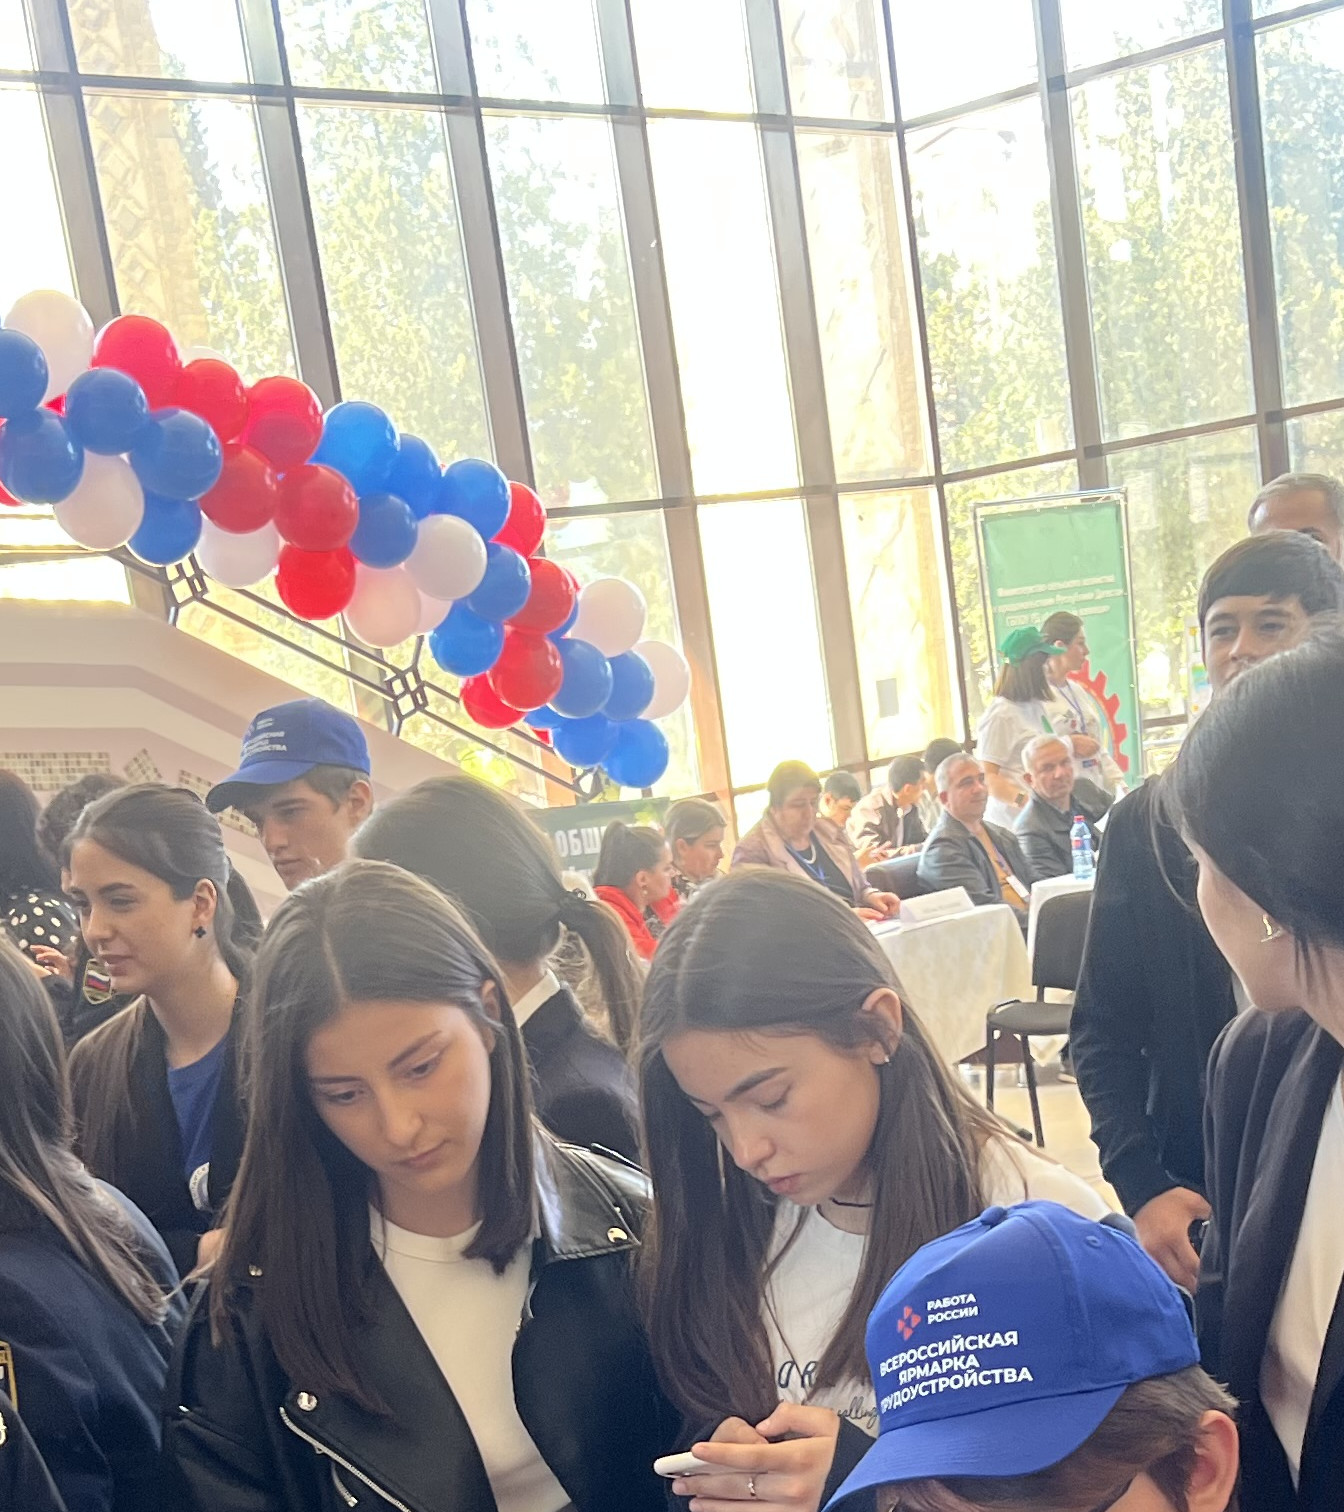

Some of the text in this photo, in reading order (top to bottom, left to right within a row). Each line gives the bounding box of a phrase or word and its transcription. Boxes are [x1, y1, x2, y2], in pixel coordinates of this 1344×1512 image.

[926, 1293, 977, 1311] РАБОТА
[927, 1305, 979, 1325] РОССИИ
[879, 1330, 1019, 1377] ВСЕРОССИЙСКАЯ
[898, 1353, 981, 1386] ЯРМАРКА
